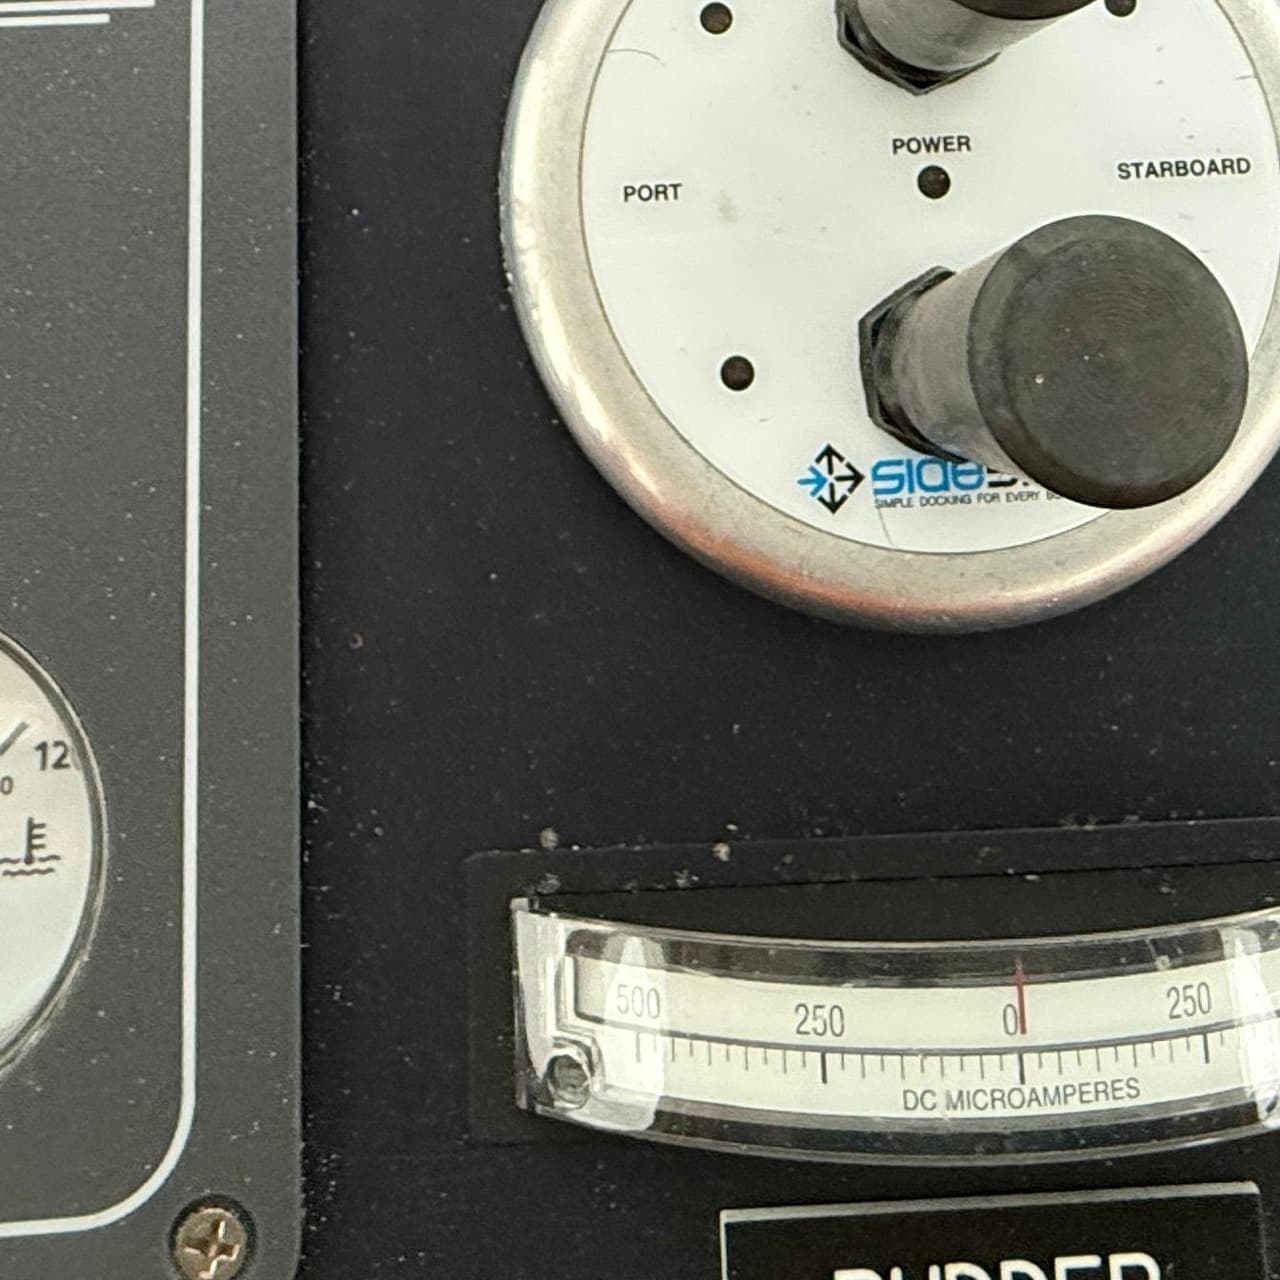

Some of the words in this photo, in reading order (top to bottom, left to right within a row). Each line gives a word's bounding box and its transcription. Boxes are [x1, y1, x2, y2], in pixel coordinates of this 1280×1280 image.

[891, 135, 972, 156] POWER
[1116, 157, 1252, 181] STARBOARD
[622, 182, 683, 203] PORT
[874, 496, 914, 509] SIMPLE
[920, 494, 972, 507] DOCKING
[977, 493, 1001, 505] FOR
[1006, 491, 1040, 503] EVERY
[33, 740, 77, 772] 12
[615, 982, 662, 1019] 500
[1166, 981, 1212, 1020] 250
[793, 1002, 846, 1038] 250
[1002, 1003, 1019, 1036] 0
[902, 1088, 938, 1112] DC
[945, 1076, 1142, 1112] MICROAMPERES
